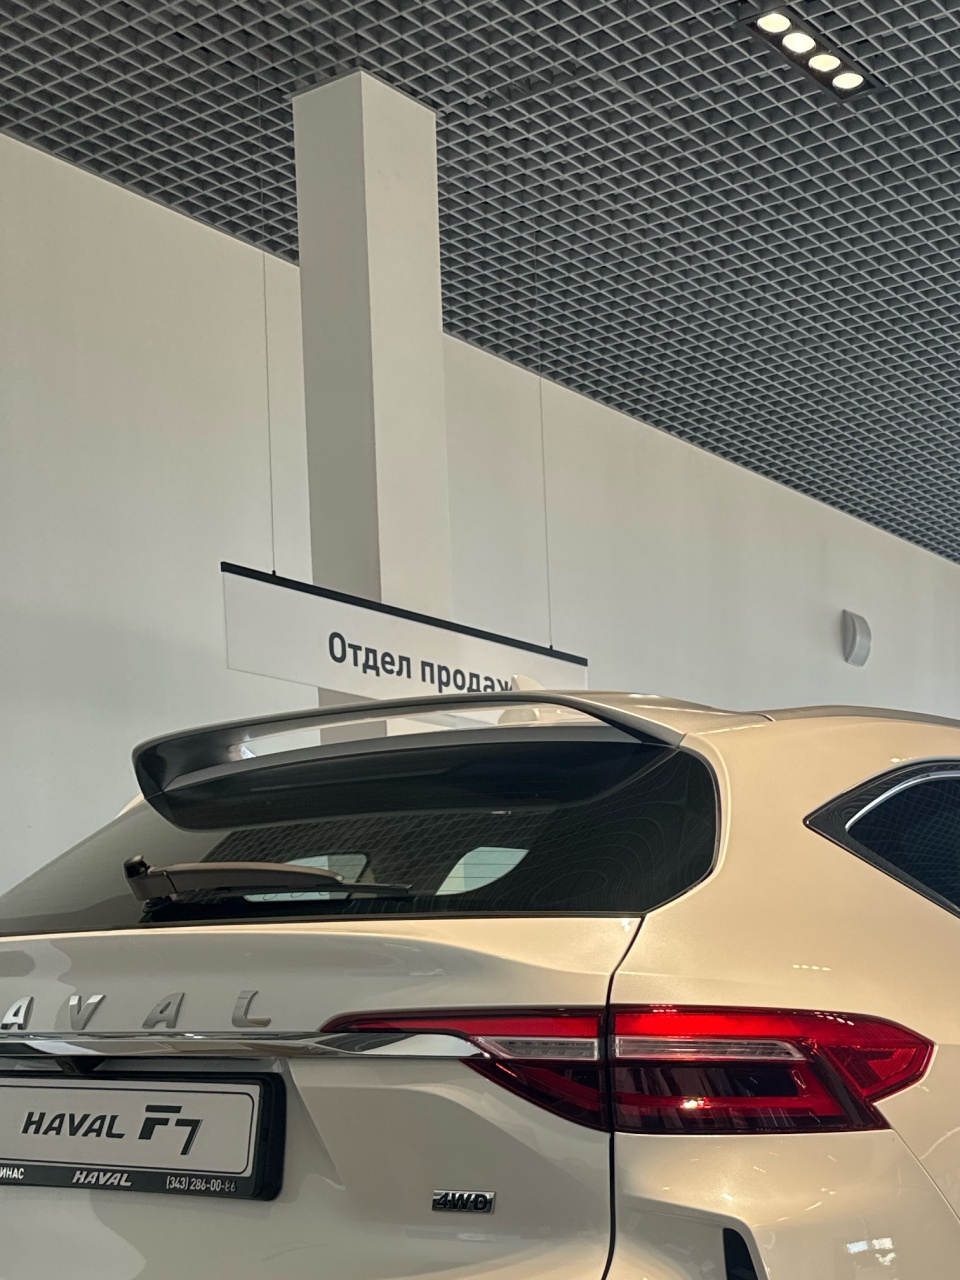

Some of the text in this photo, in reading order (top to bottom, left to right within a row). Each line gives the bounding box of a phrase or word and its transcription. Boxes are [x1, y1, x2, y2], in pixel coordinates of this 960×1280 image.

[329, 631, 411, 680] Отдел
[21, 1104, 204, 1156] HAVAL F7
[71, 1170, 133, 1187] HAVAL
[166, 1175, 189, 1191] (343)
[436, 1192, 488, 1211] 4WD
